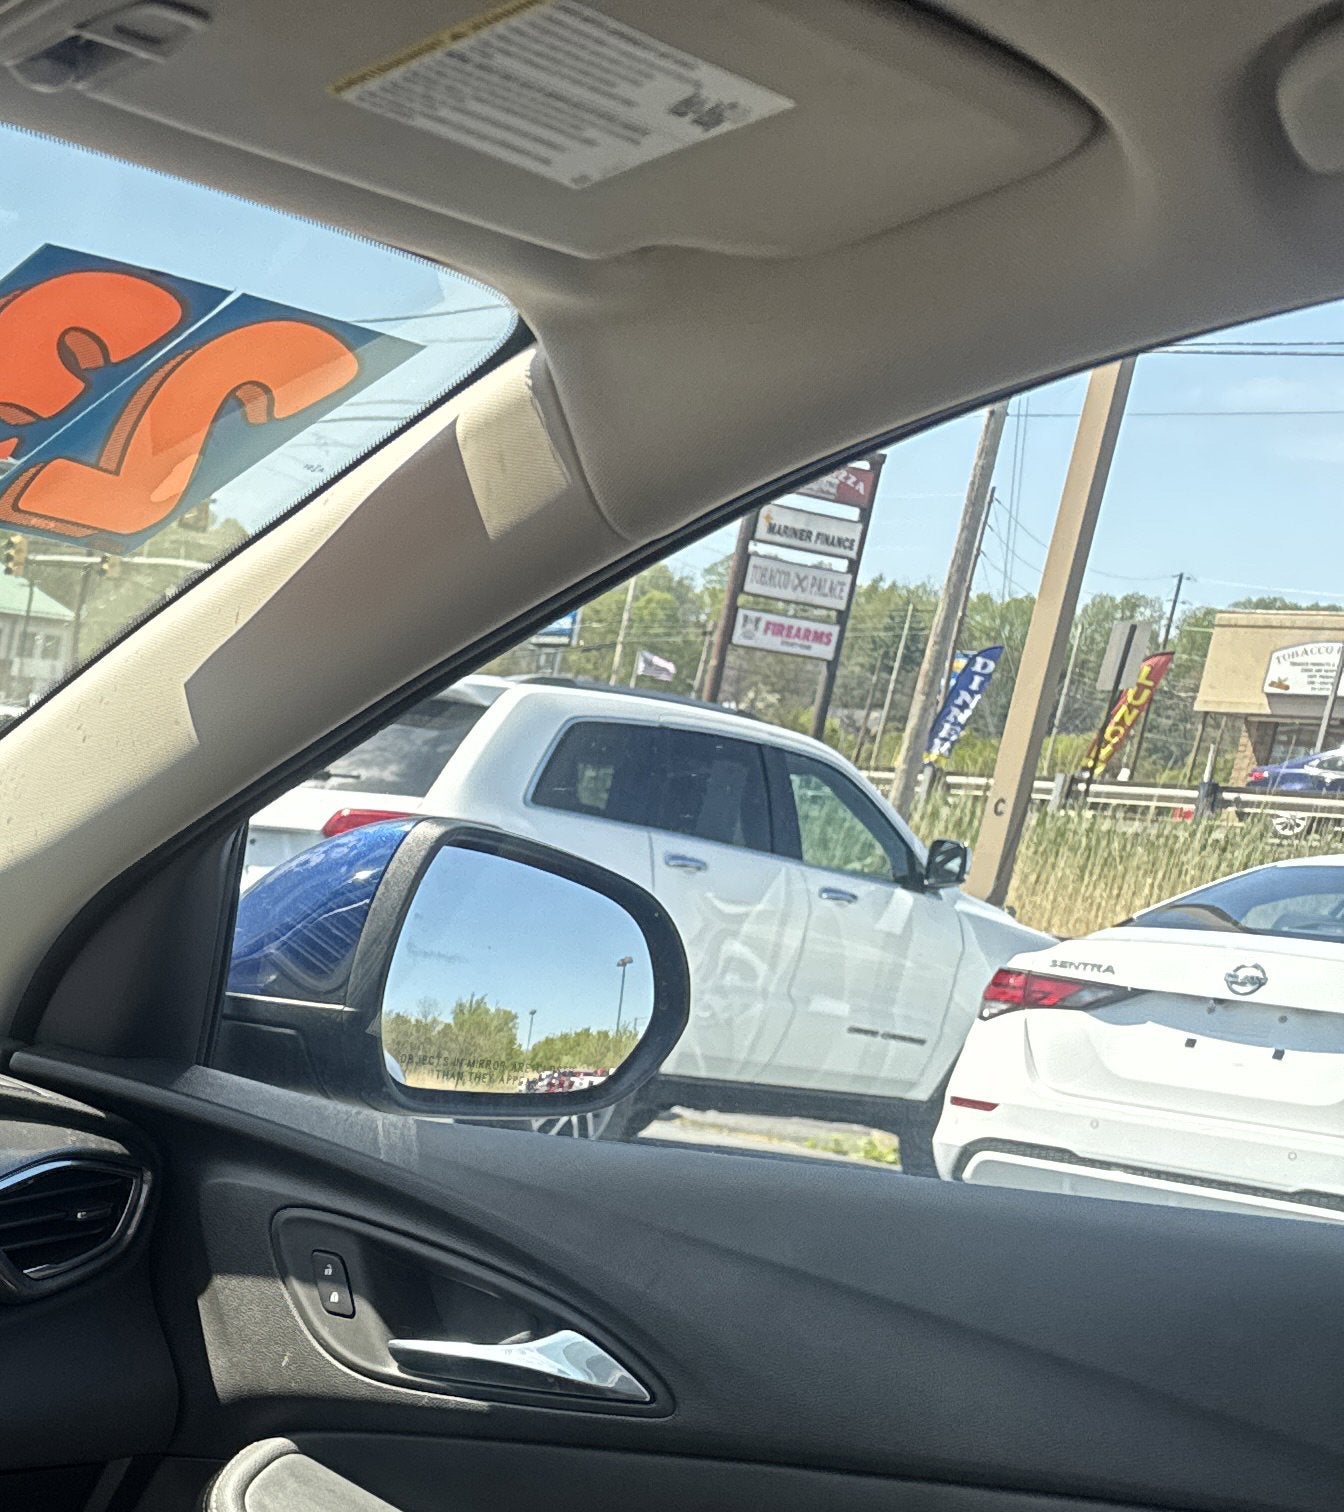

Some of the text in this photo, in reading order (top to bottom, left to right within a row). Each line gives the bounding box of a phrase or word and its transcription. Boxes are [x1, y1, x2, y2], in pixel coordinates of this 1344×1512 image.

[767, 522, 856, 552] MARINER FINANCE
[749, 564, 847, 601] TOBACCO PALACE
[763, 620, 833, 647] FIREARMS
[1275, 644, 1334, 665] TOBACCO
[1048, 958, 1116, 976] SENTRA
[400, 1054, 450, 1067] OBJECTS
[453, 1057, 466, 1067] IN
[467, 1058, 506, 1072] MIRROR
[435, 1068, 464, 1083] THAN
[467, 1071, 494, 1085] THEY
